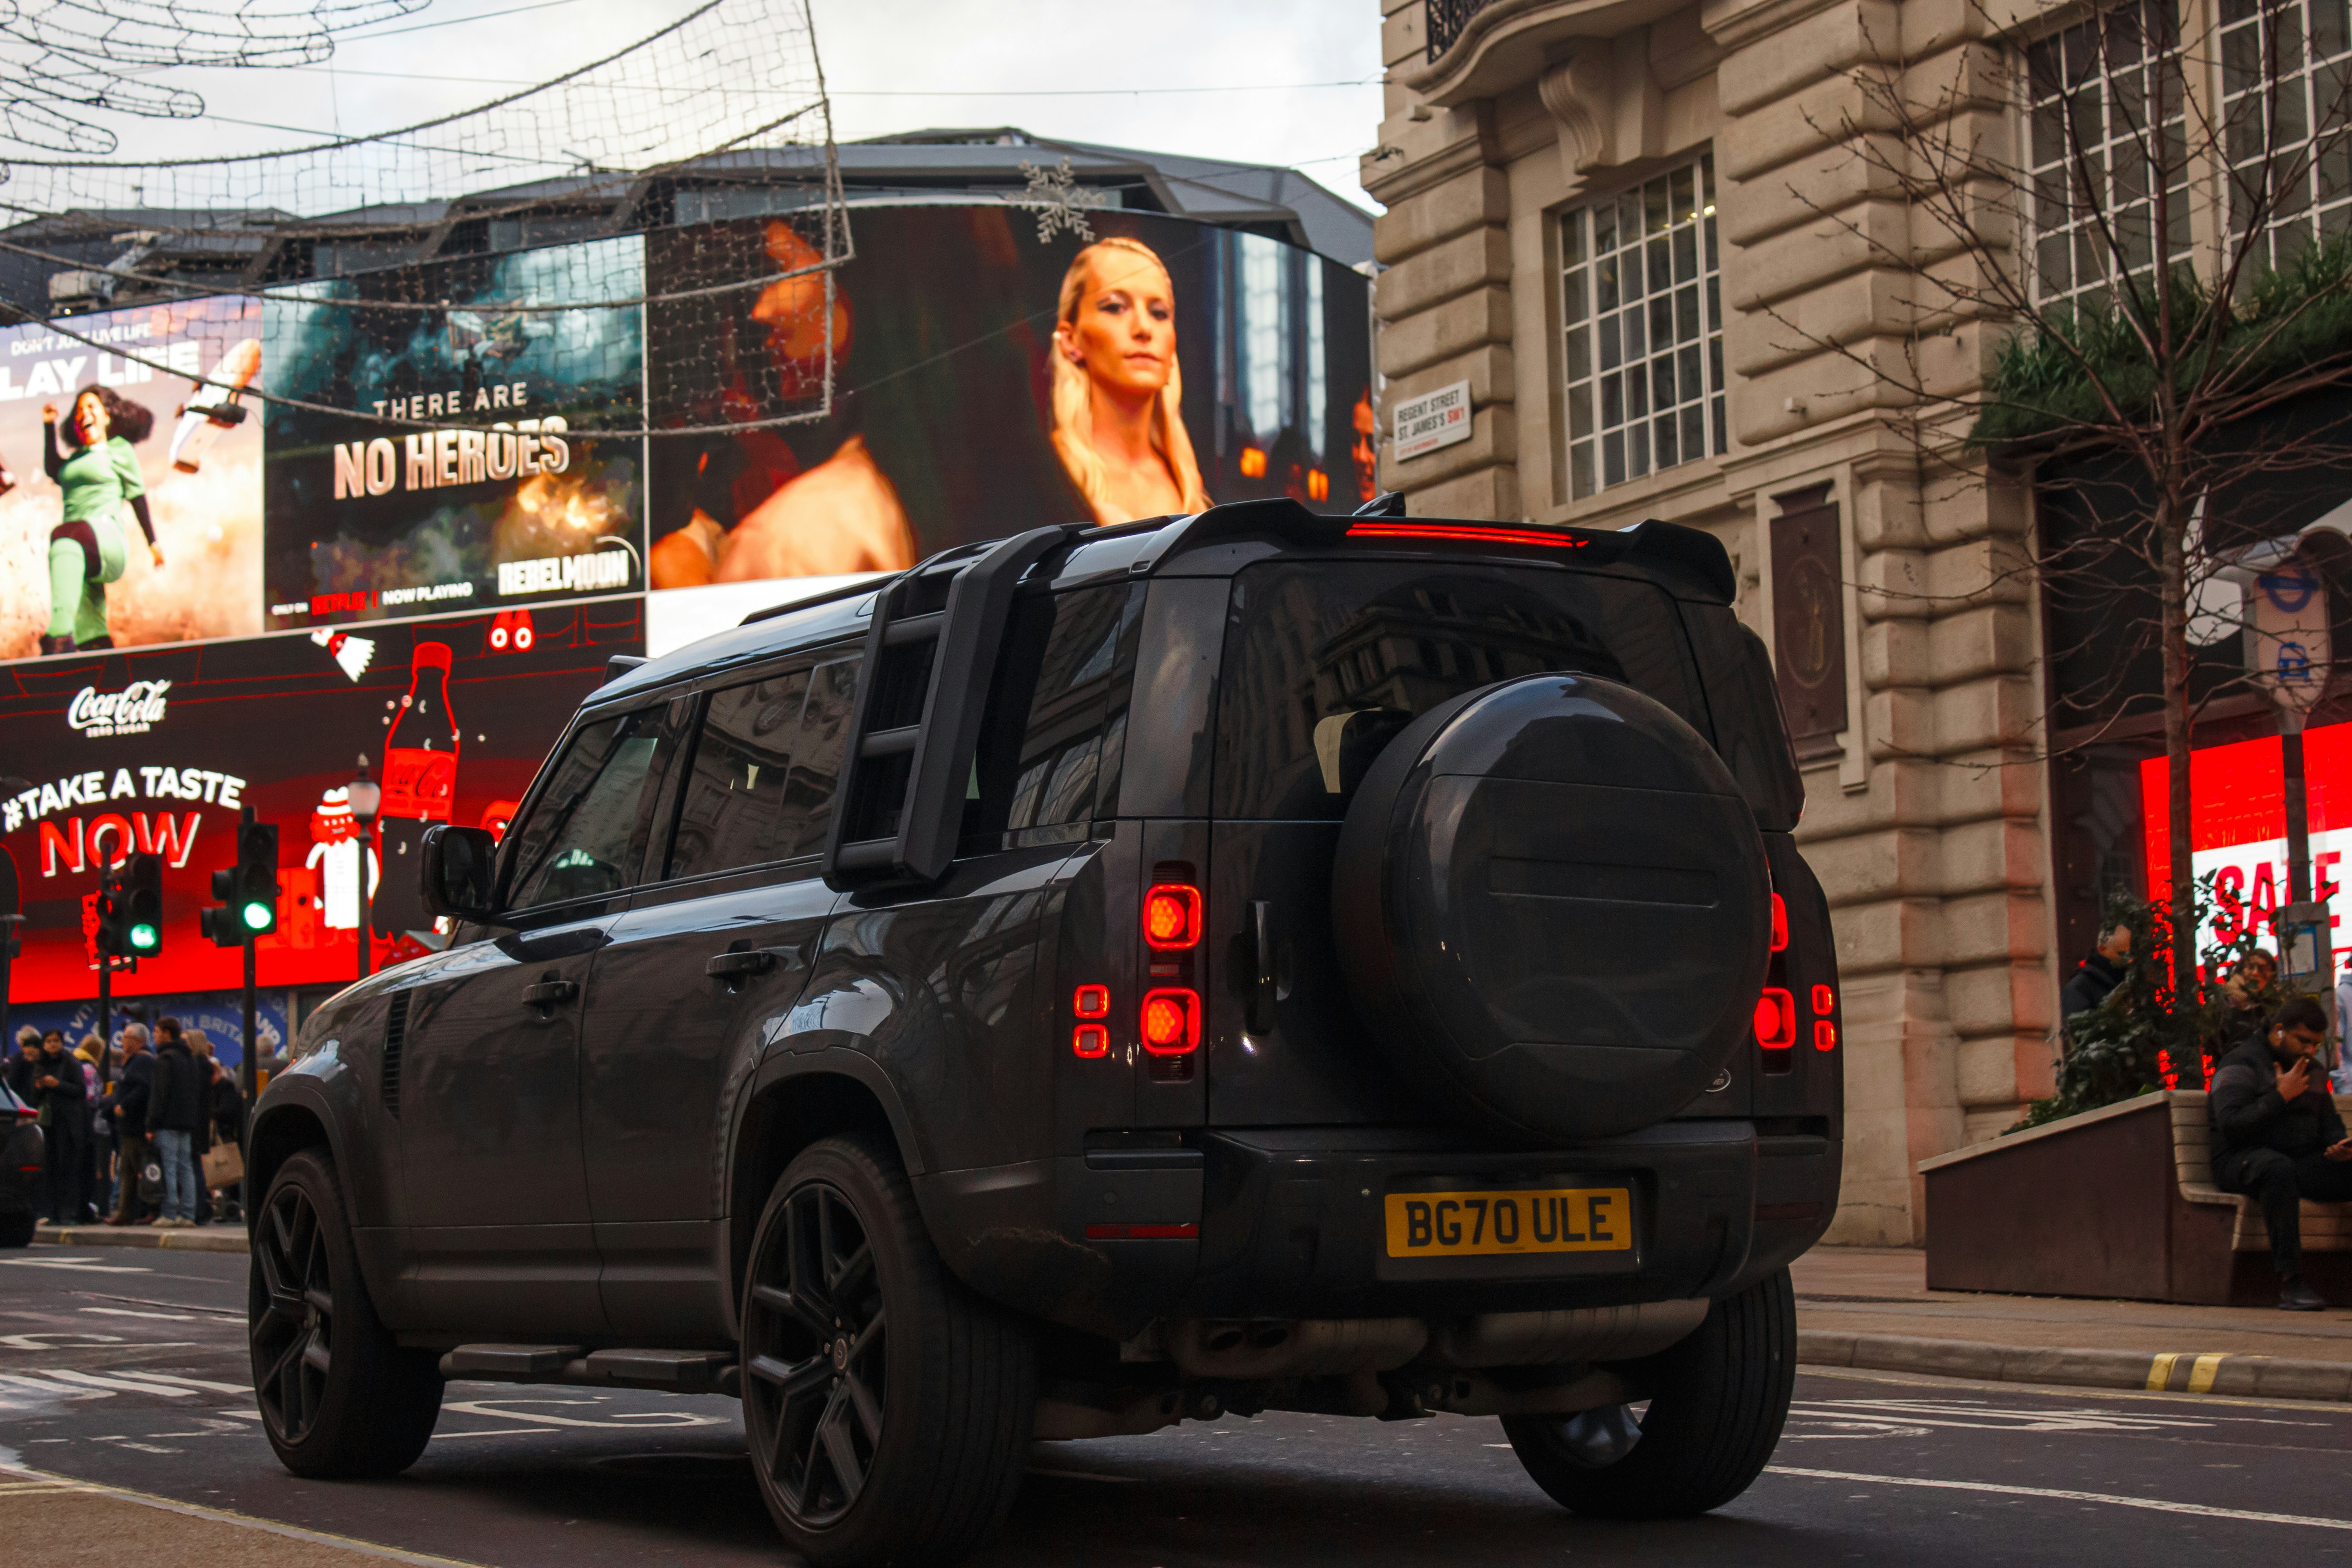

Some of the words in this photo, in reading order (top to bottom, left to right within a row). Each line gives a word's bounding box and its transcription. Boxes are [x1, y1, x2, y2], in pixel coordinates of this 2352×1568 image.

[10, 336, 54, 356] DON'T
[92, 326, 122, 344] LIVE
[124, 322, 152, 341] LIFE
[98, 340, 200, 387] LIFE
[372, 391, 461, 420] THERE
[475, 382, 528, 411] ARE
[1398, 401, 1427, 422] REGENT
[1431, 389, 1459, 412] STREET
[1447, 406, 1465, 424] SW1
[334, 437, 396, 500] NO
[405, 415, 570, 490] HEROES
[498, 557, 563, 596] REBEL
[562, 549, 629, 591] MOON
[311, 590, 367, 616] NETFLIX
[382, 588, 416, 606] NOW
[416, 582, 473, 601] PLAYING
[1, 771, 106, 832] #TAKE
[110, 768, 136, 799] A
[139, 766, 246, 809] TASTE
[39, 811, 201, 877] NOW
[2214, 850, 2341, 945] SAE
[1405, 1199, 1520, 1247] BG70
[1532, 1196, 1614, 1243] ULE
